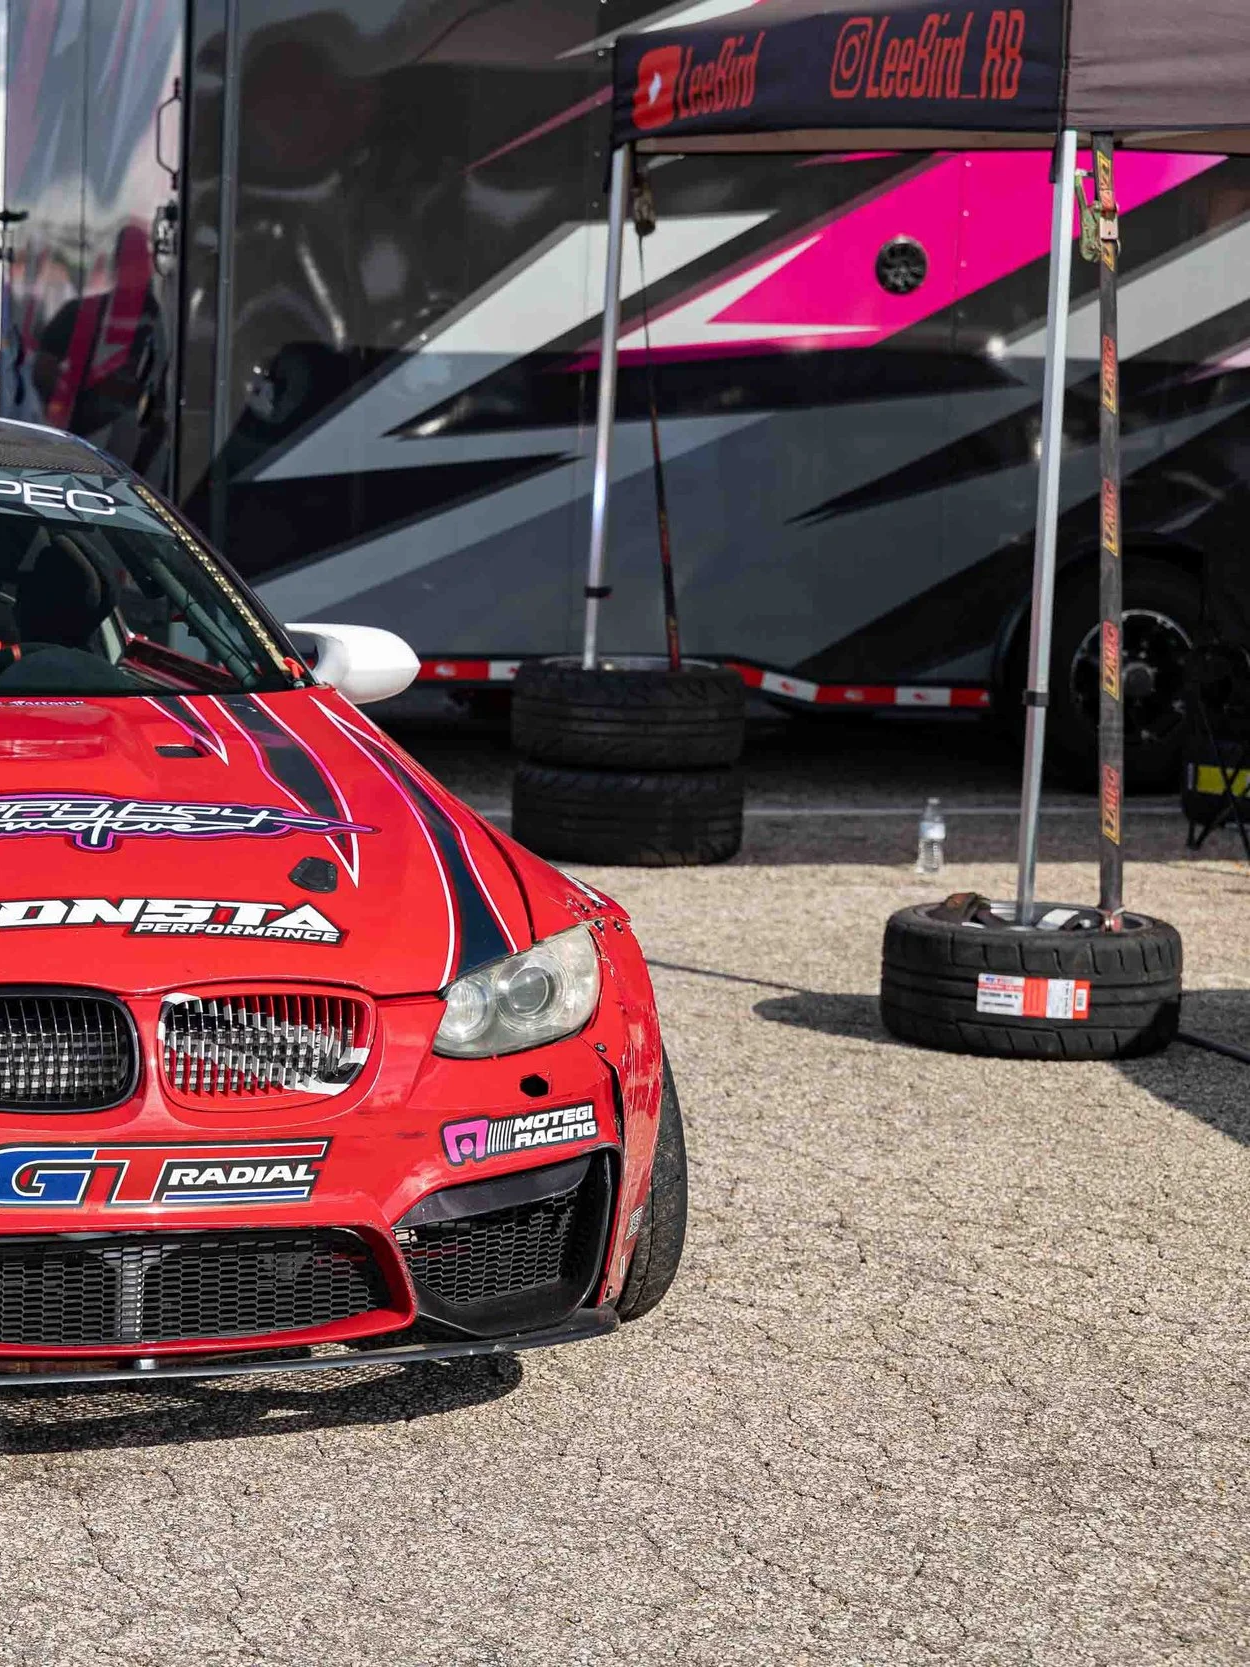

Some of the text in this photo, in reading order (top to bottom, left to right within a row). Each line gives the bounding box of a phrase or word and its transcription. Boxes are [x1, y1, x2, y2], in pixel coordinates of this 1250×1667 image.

[866, 9, 1025, 99] LeeBird_RB
[677, 31, 765, 118] LeeBird
[134, 921, 340, 942] PERFORMANCE
[513, 1104, 594, 1133] MOTEGI
[514, 1120, 598, 1149] RACING
[168, 1163, 316, 1187] RADIAL
